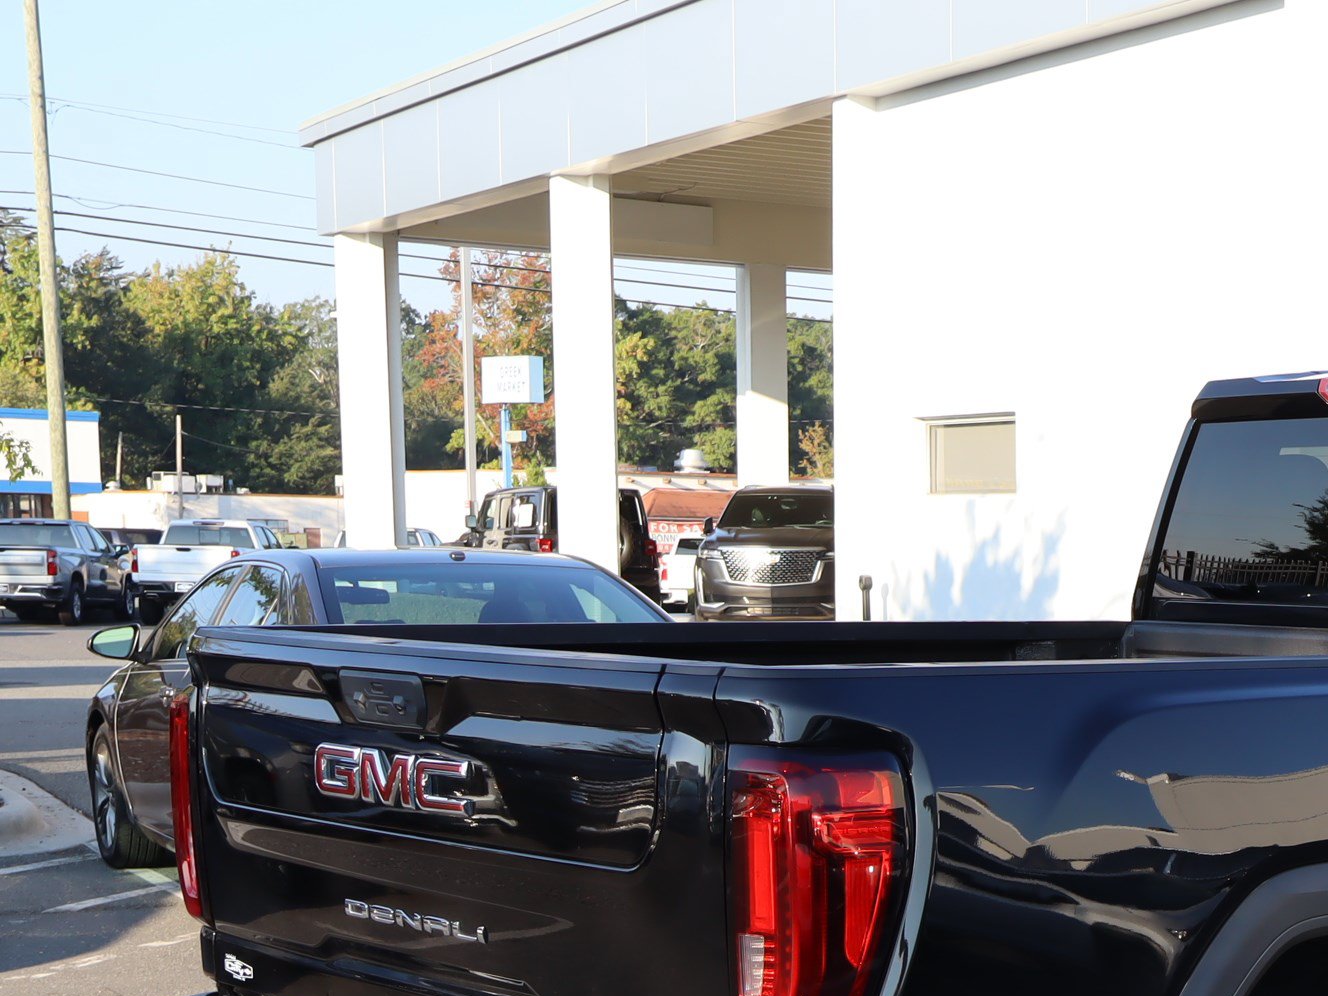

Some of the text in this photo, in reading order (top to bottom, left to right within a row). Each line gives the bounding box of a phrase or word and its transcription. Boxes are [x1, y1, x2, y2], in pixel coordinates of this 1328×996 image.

[650, 521, 679, 534] FOR
[314, 741, 475, 818] GMC
[344, 897, 489, 945] DENALI
